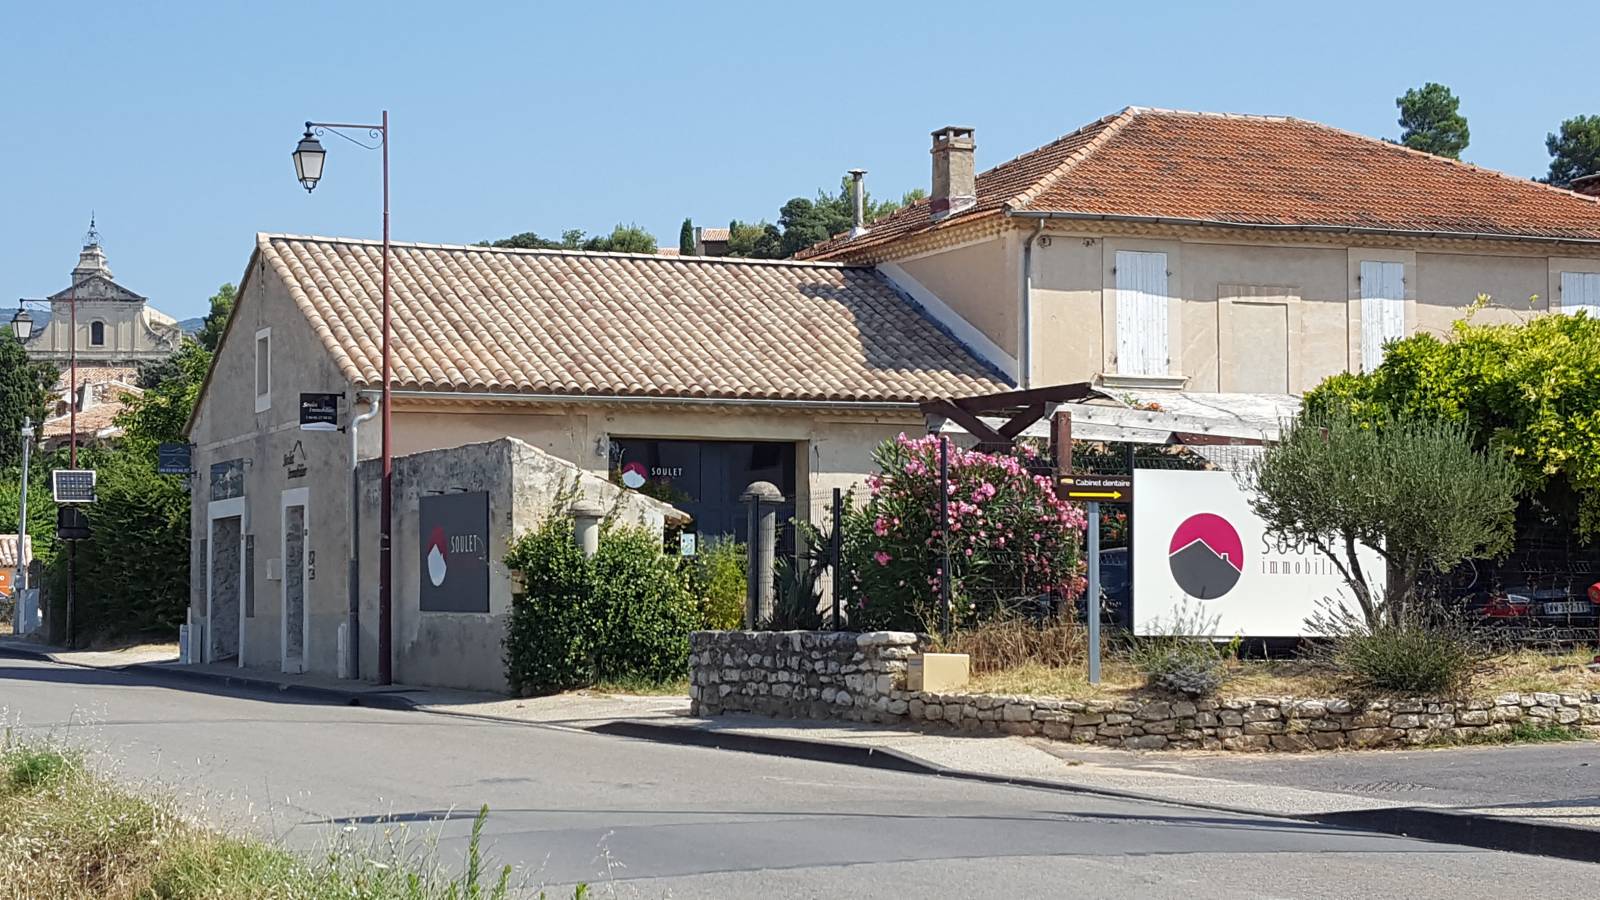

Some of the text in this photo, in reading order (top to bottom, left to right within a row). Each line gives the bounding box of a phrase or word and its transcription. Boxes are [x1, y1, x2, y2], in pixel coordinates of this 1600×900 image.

[651, 467, 683, 476] SOULET
[1075, 479, 1131, 487] Cabinet dentaire
[450, 534, 478, 553] SOULET
